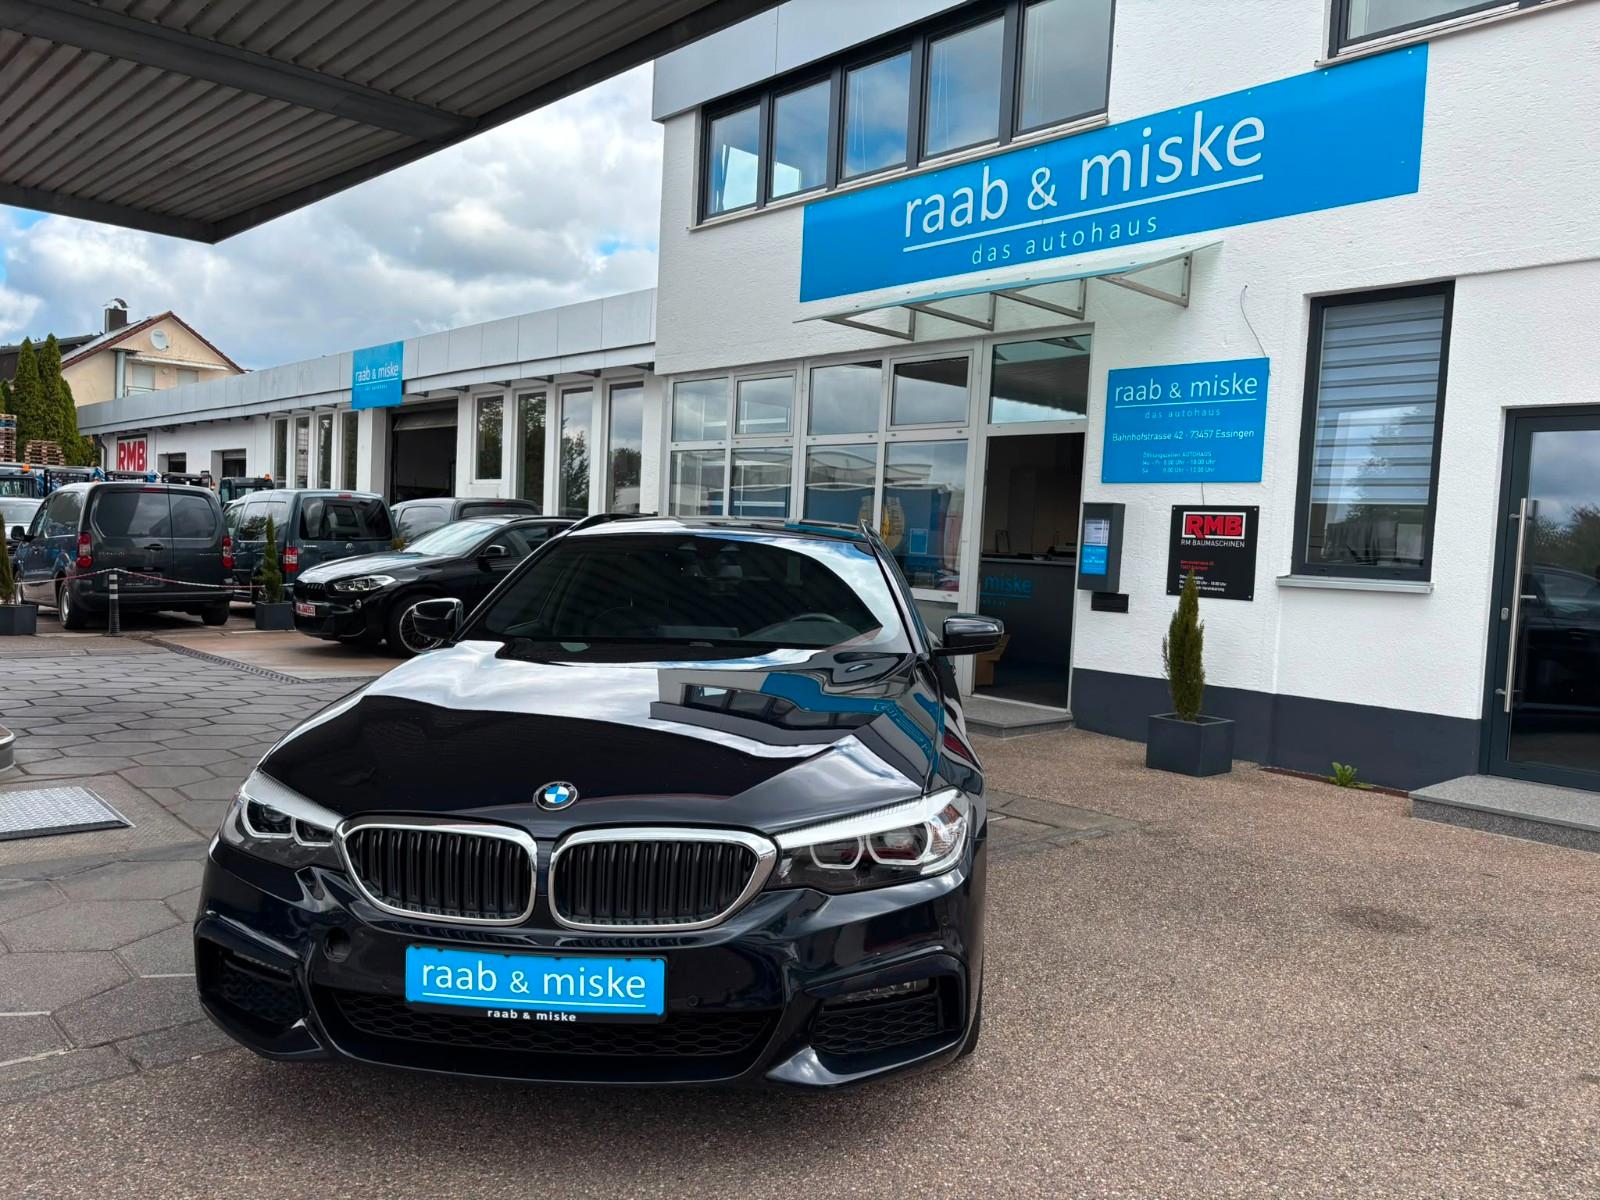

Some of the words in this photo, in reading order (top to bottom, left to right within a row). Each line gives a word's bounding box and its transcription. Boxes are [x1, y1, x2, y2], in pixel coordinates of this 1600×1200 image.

[905, 165, 1009, 238] raab
[1027, 166, 1058, 211] &
[1080, 110, 1265, 201] miske
[972, 243, 1011, 265] das
[1025, 216, 1158, 255] autohaus
[355, 365, 371, 382] raab
[378, 361, 399, 378] miske
[1115, 377, 1162, 402] raab
[1169, 382, 1182, 399] &
[1190, 372, 1258, 398] miske
[1144, 410, 1163, 419] das
[1168, 408, 1222, 418] autohaus
[1112, 432, 1172, 442] Bahnhofstrasse
[1174, 431, 1184, 440] 42
[1190, 429, 1214, 439] 73457
[1215, 429, 1255, 440] Essingen
[118, 440, 146, 472] RMB
[1185, 514, 1243, 539] RMB
[1192, 540, 1245, 548] BAUMASCHINEN
[984, 573, 1033, 593] miske
[422, 960, 497, 992] raab
[509, 970, 530, 994] &
[543, 966, 647, 999] miske
[487, 1009, 518, 1019] raab
[522, 1012, 531, 1020] &
[536, 1011, 577, 1022] miske
